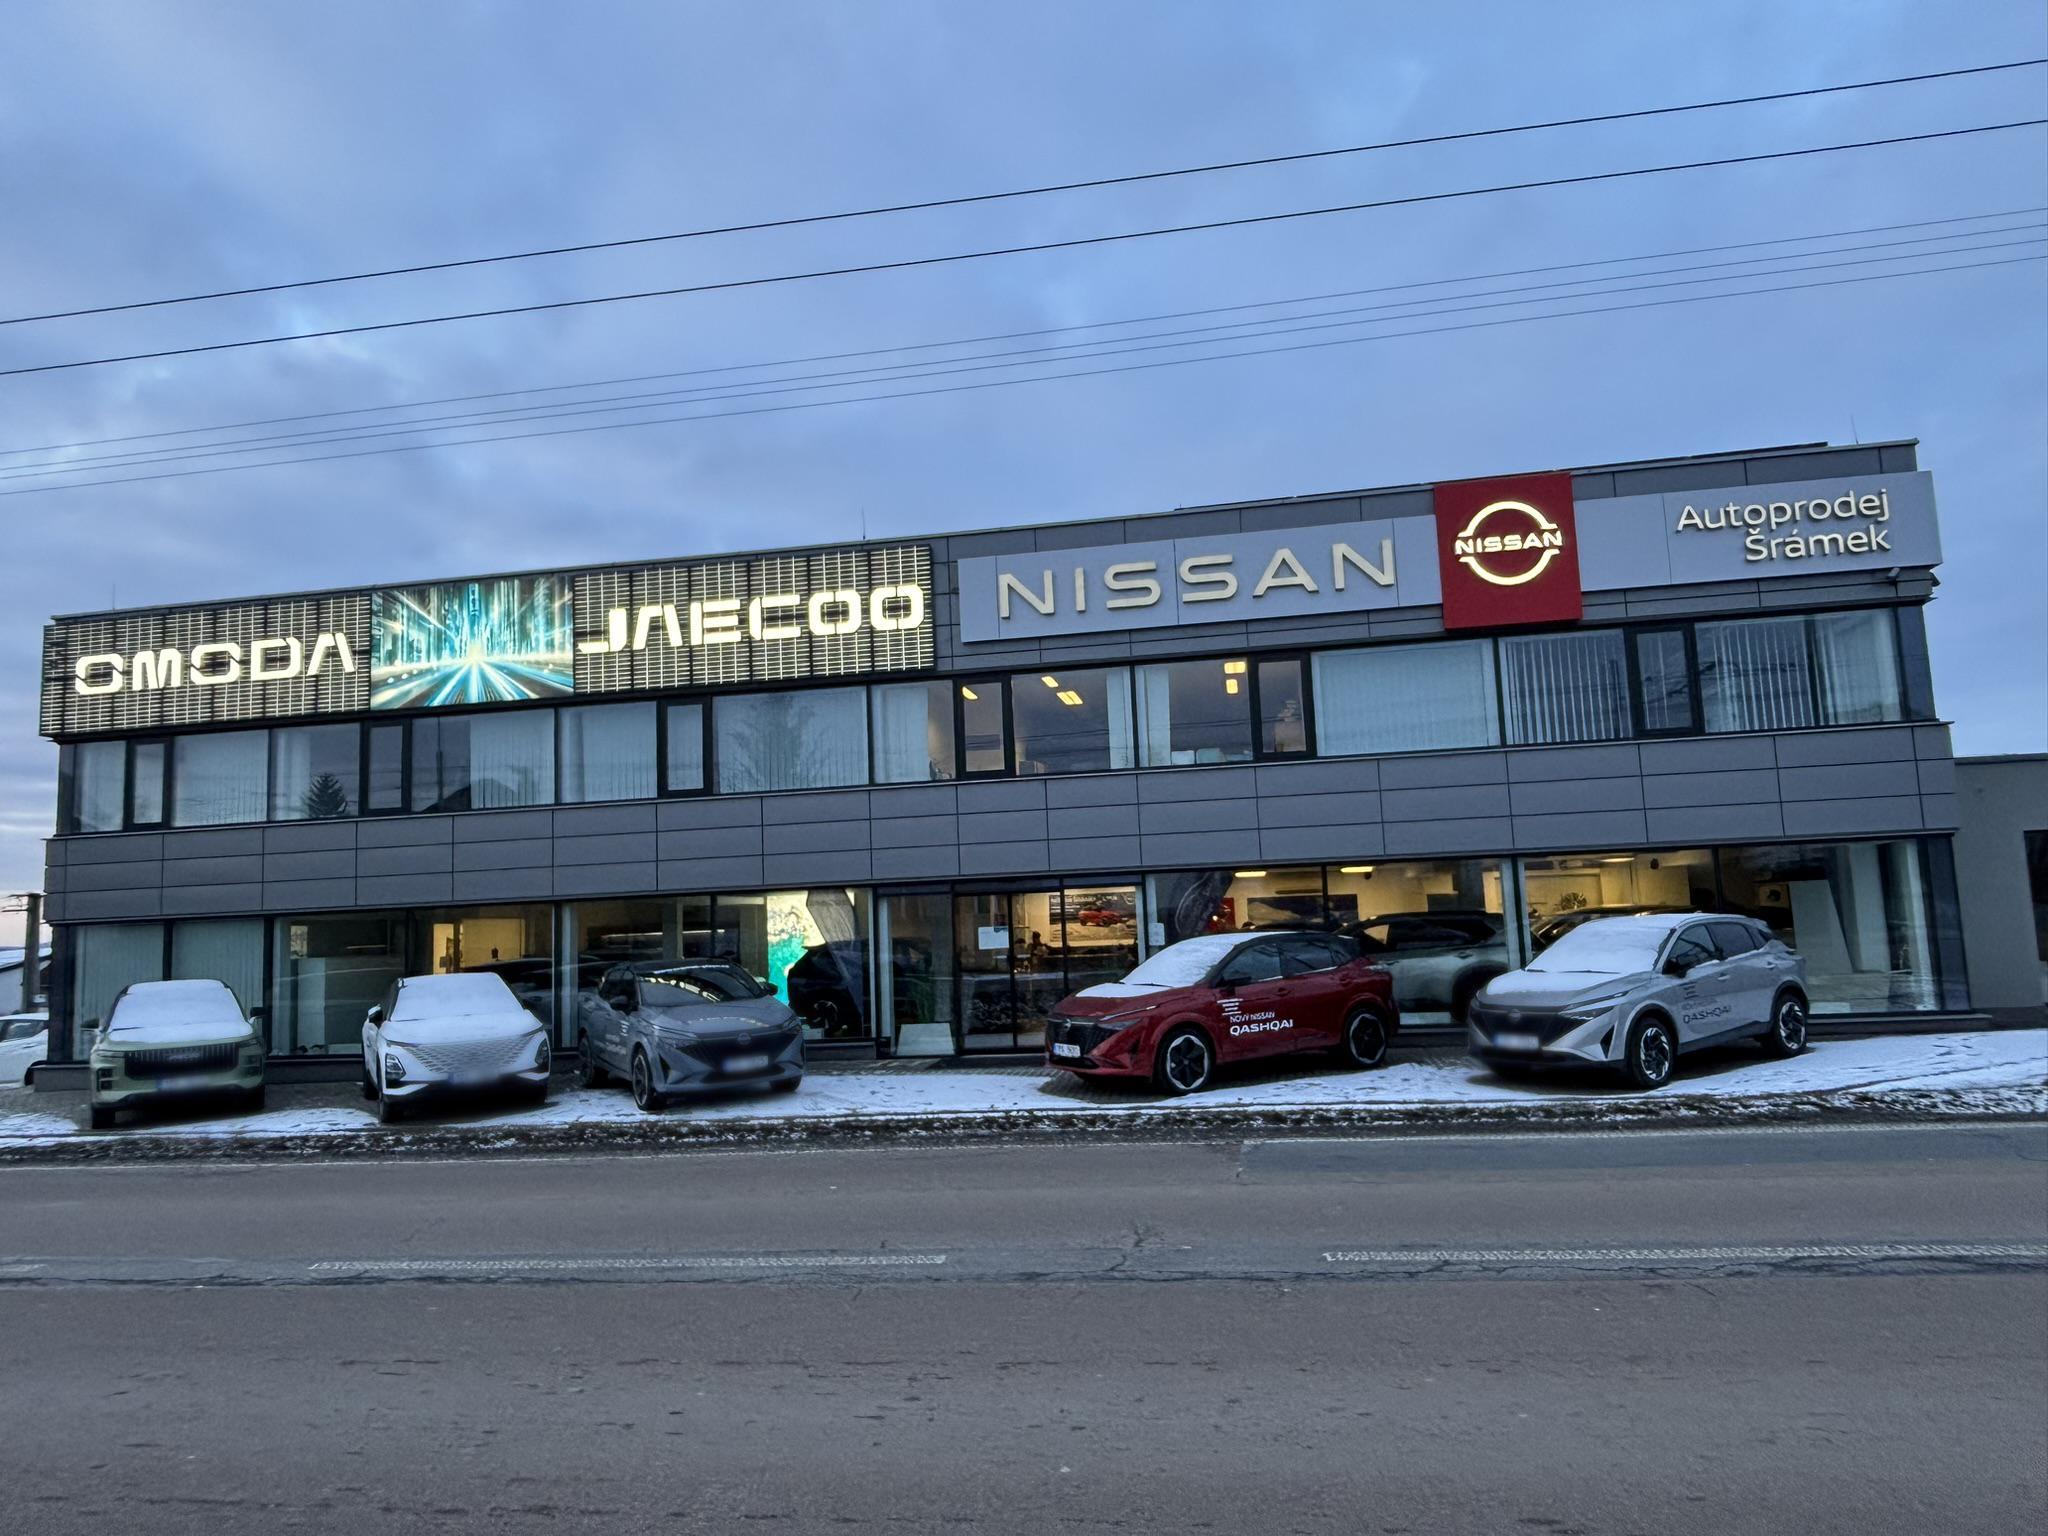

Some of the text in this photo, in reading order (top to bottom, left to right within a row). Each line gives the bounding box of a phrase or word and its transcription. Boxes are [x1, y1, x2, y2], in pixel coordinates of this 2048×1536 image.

[1677, 488, 1889, 532] Autoprodej
[1455, 530, 1563, 555] NISSAN
[1744, 525, 1891, 562] Šrámek
[999, 538, 1395, 620] NISSAN
[578, 583, 925, 655] JAECOO
[75, 632, 356, 696] OMODA
[1230, 1019, 1294, 1036] QASHQAI
